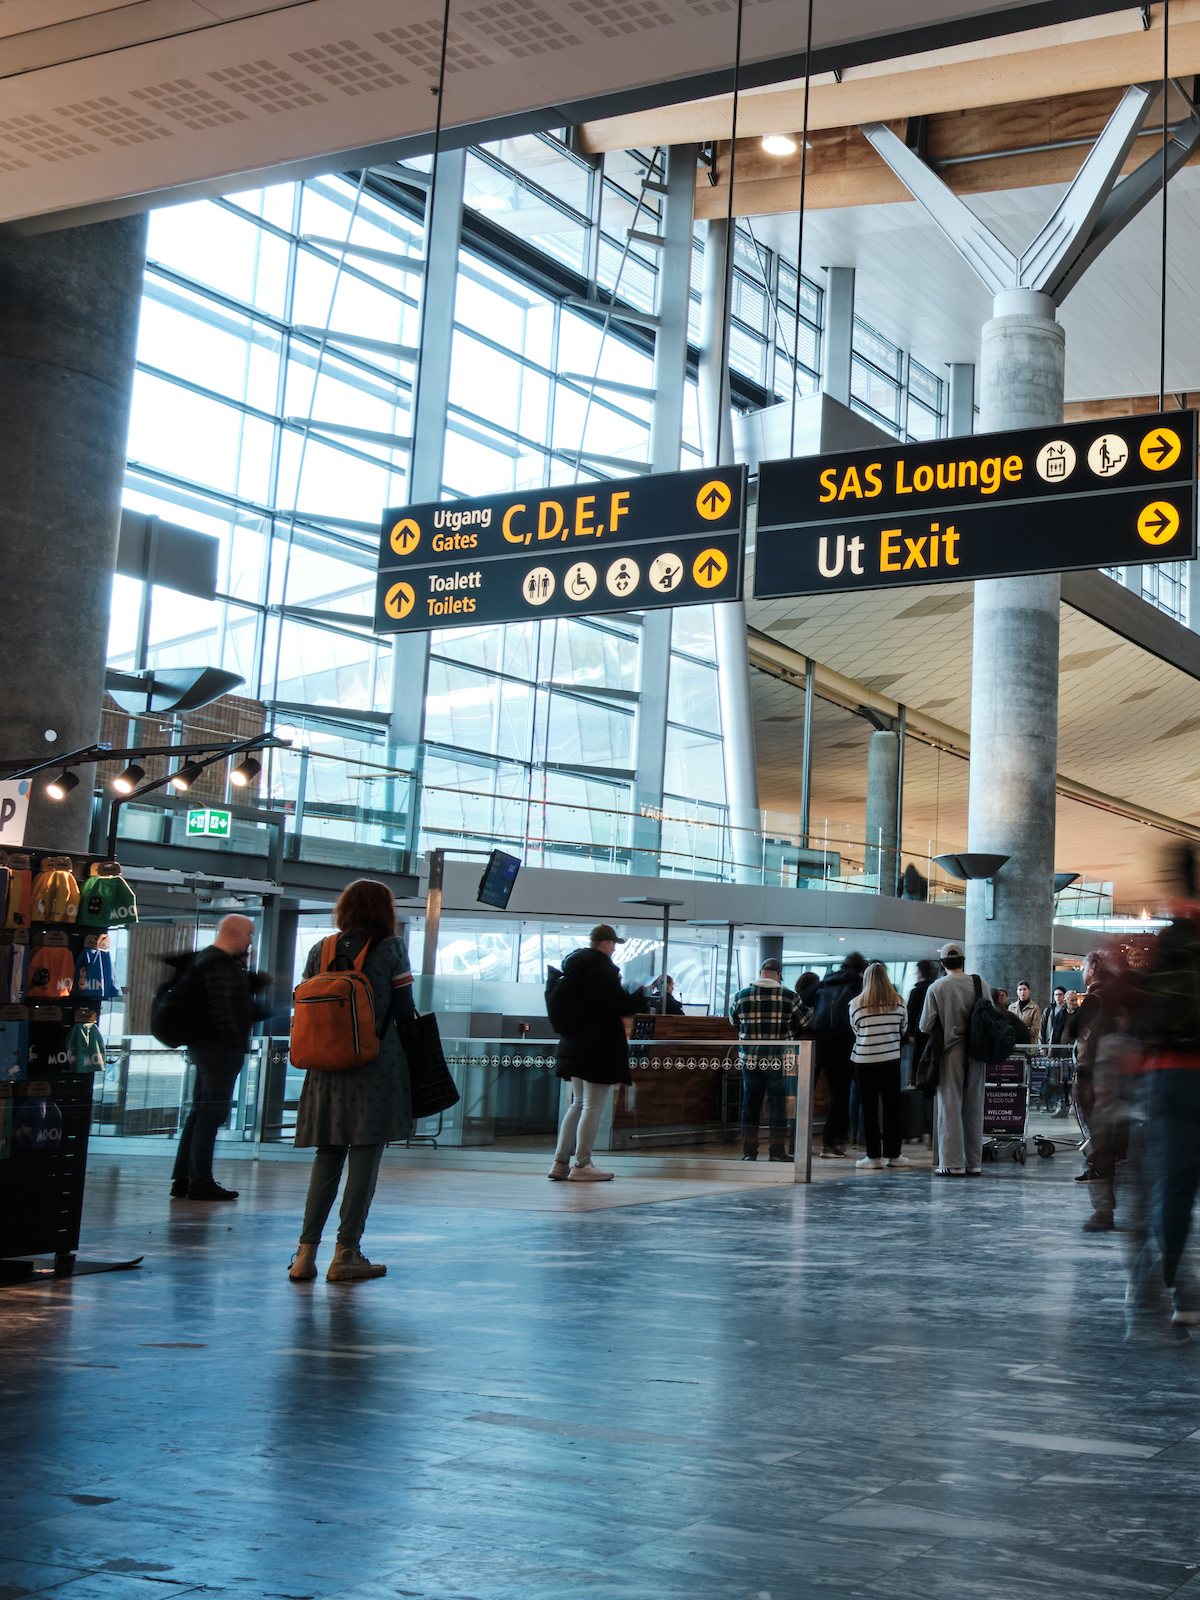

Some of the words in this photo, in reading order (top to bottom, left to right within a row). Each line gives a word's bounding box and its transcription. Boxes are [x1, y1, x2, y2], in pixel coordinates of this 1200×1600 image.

[819, 462, 883, 503] SAS
[895, 454, 1024, 495] Lounge
[433, 508, 492, 532] Utgang
[432, 532, 478, 552] Gates
[818, 534, 865, 578] Ut
[879, 522, 960, 572] Exit
[428, 570, 482, 593] Toalett
[427, 595, 476, 616] Toilets
